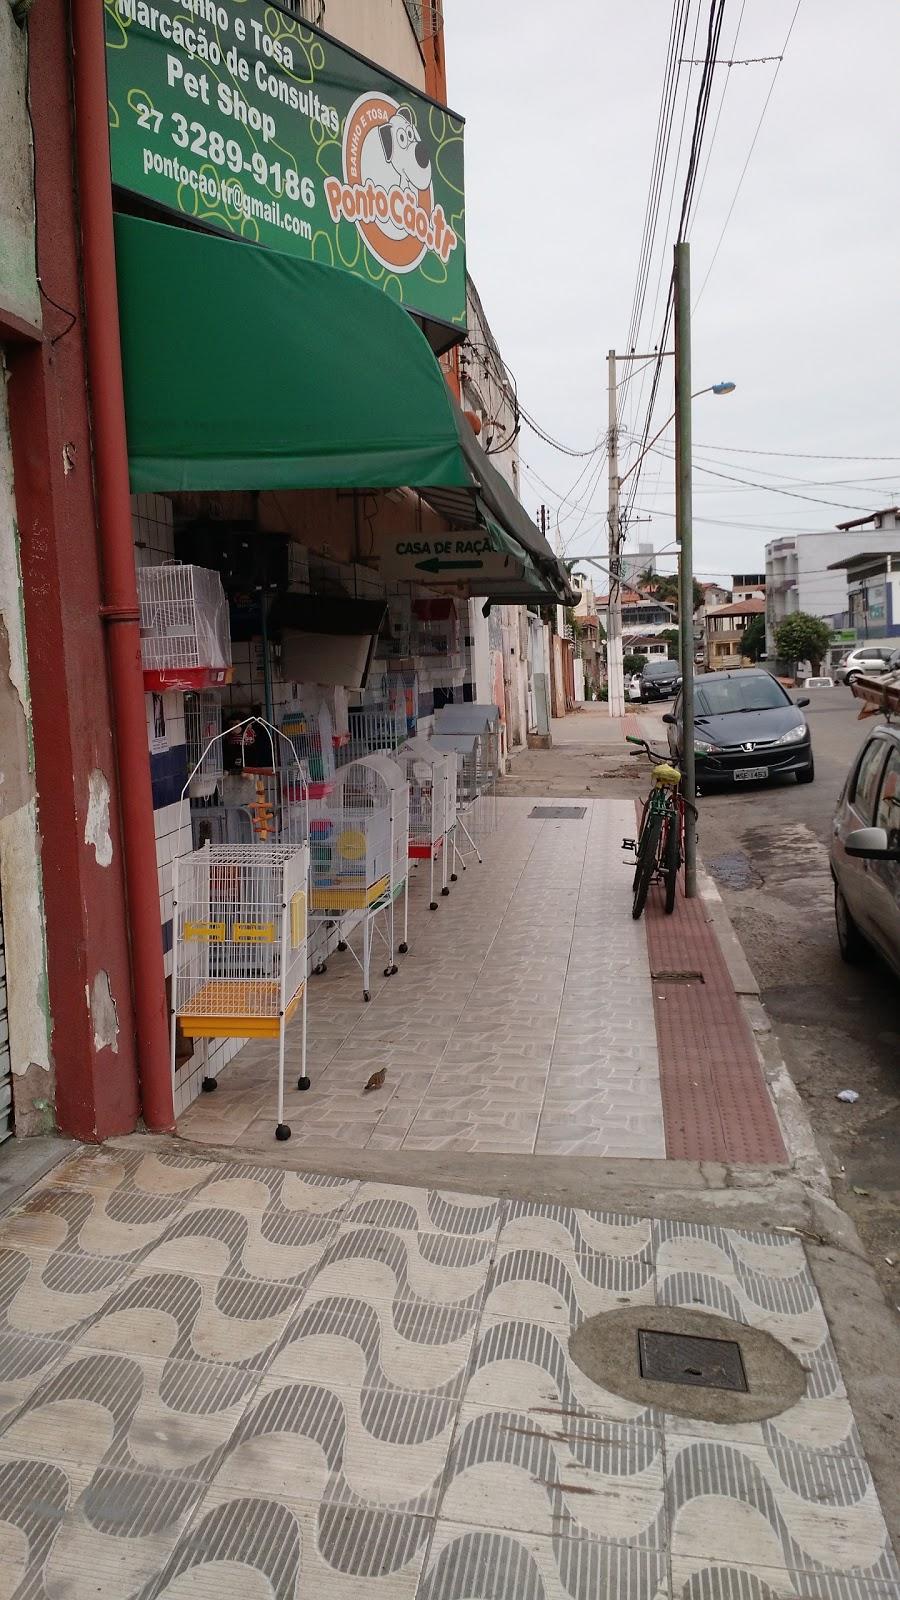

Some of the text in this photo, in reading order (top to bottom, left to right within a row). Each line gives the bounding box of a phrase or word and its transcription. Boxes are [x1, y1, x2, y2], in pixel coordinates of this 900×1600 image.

[119, 0, 340, 132] Marcação de Consultas
[172, 0, 294, 71] nho e Tosa
[167, 53, 276, 143] Pet Shop
[136, 103, 316, 209] 27 3289-9186
[350, 109, 389, 177] BANHO E TOSA
[395, 541, 431, 555] CASA
[434, 541, 452, 554] DE
